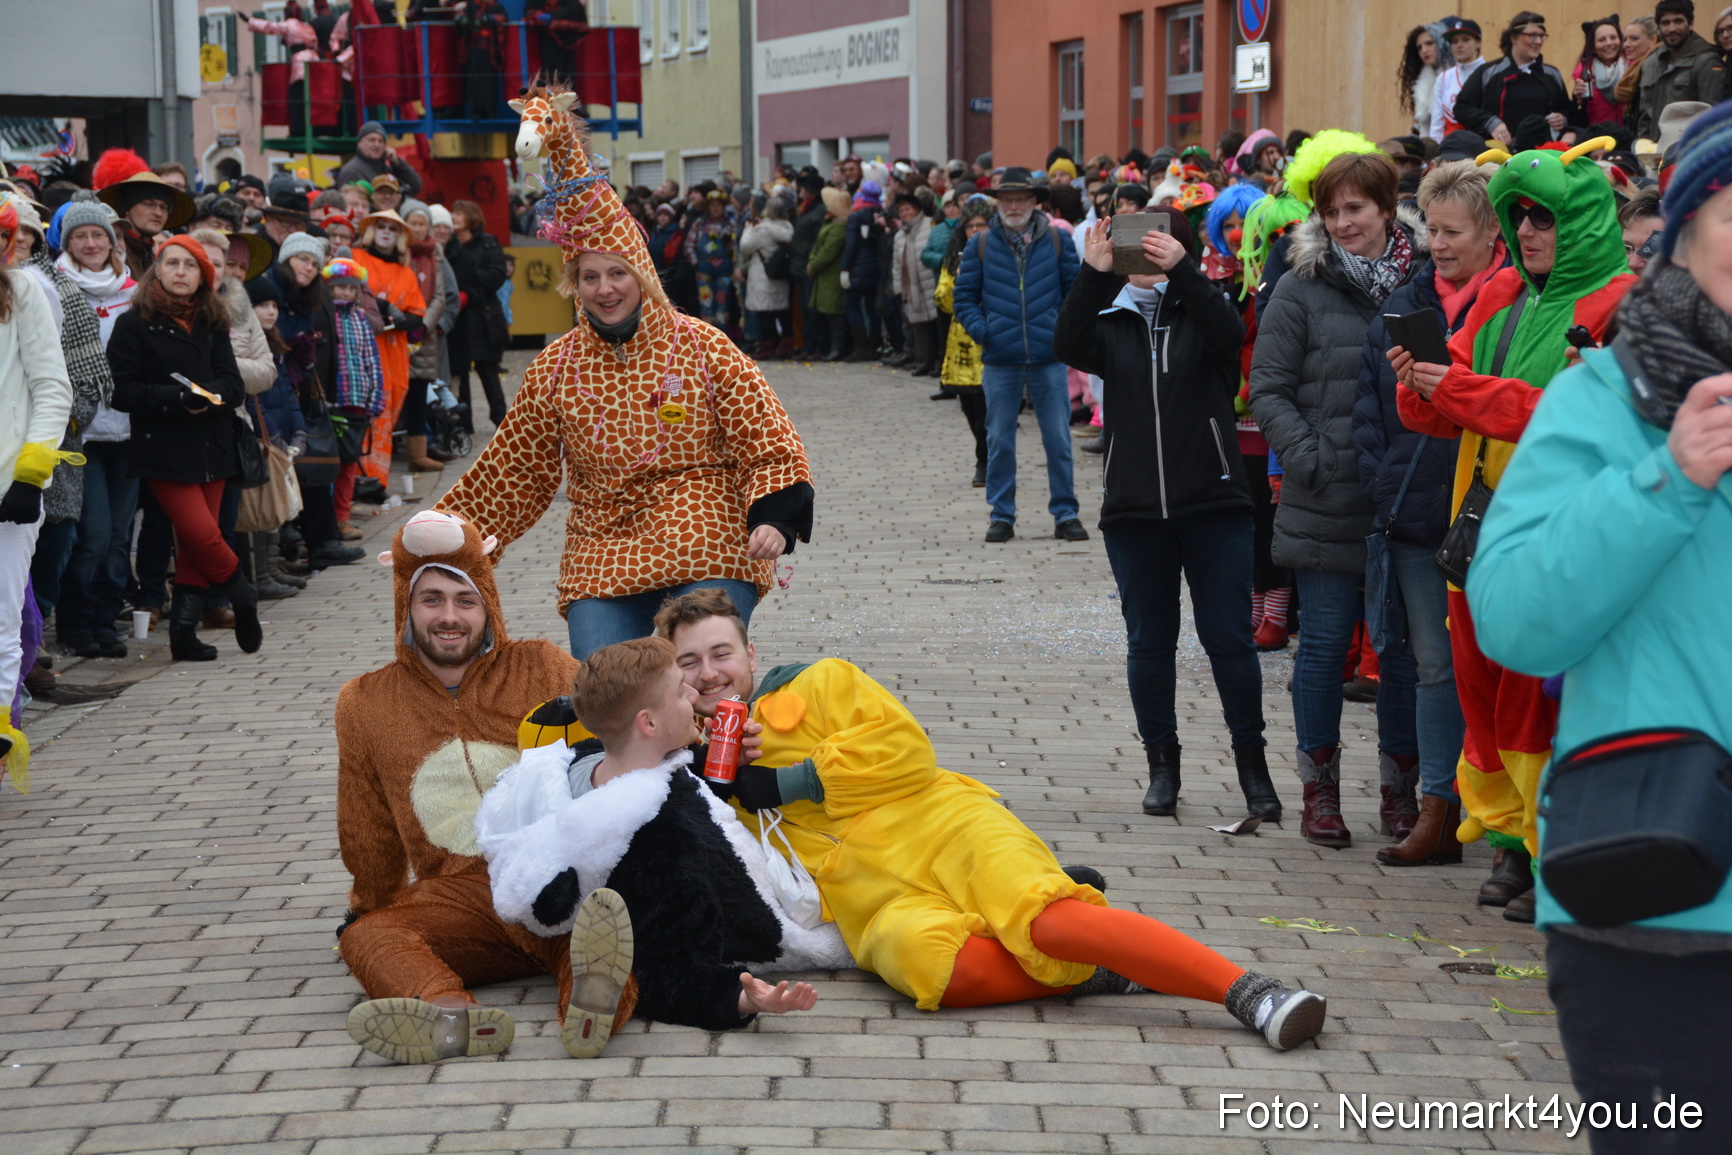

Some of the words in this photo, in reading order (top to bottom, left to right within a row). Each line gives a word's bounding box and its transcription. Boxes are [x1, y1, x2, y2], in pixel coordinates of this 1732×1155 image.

[765, 47, 842, 78] Raumausstattung
[847, 27, 900, 68] BOGNER
[712, 711, 740, 735] 5,0
